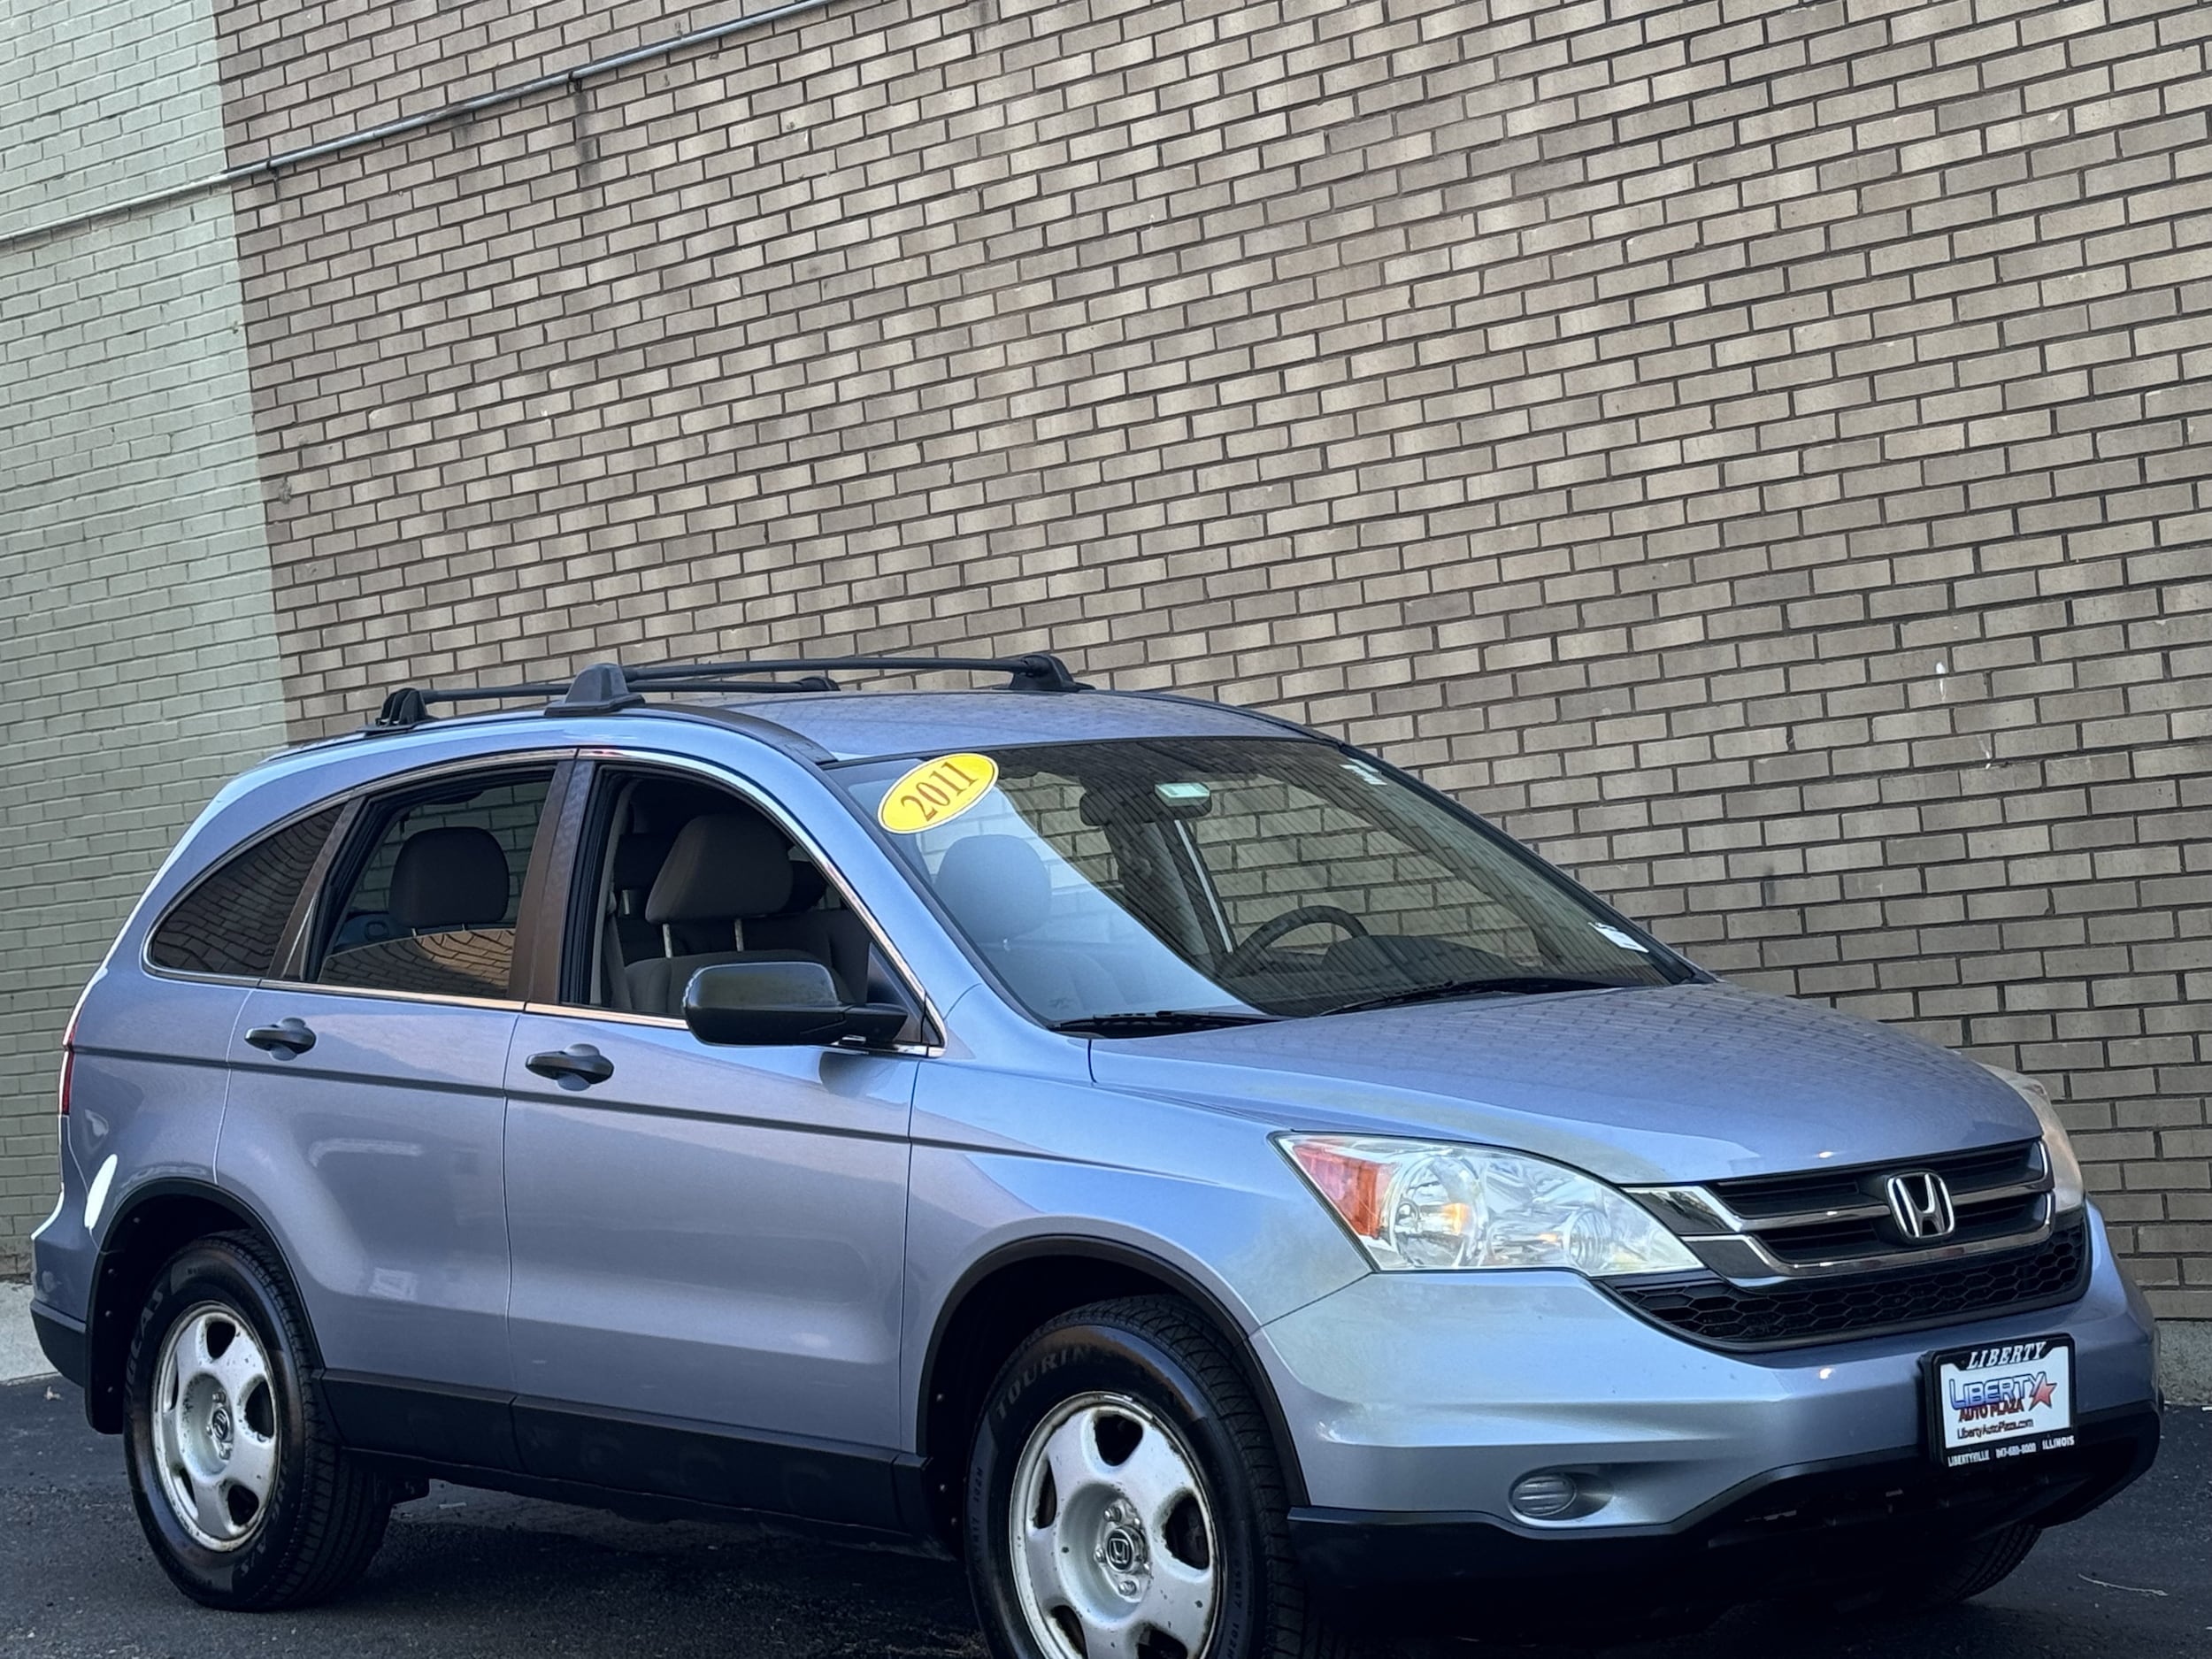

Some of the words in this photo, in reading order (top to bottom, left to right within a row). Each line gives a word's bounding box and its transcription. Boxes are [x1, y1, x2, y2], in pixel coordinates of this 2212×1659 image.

[900, 761, 979, 822] 2011
[1967, 1341, 2047, 1370] LIBERTY
[1949, 1371, 2047, 1410] LIBERTY
[1958, 1405, 1988, 1423] AUTO
[1991, 1399, 2024, 1416] PLAZA
[2041, 1435, 2075, 1450] ILLINOIS
